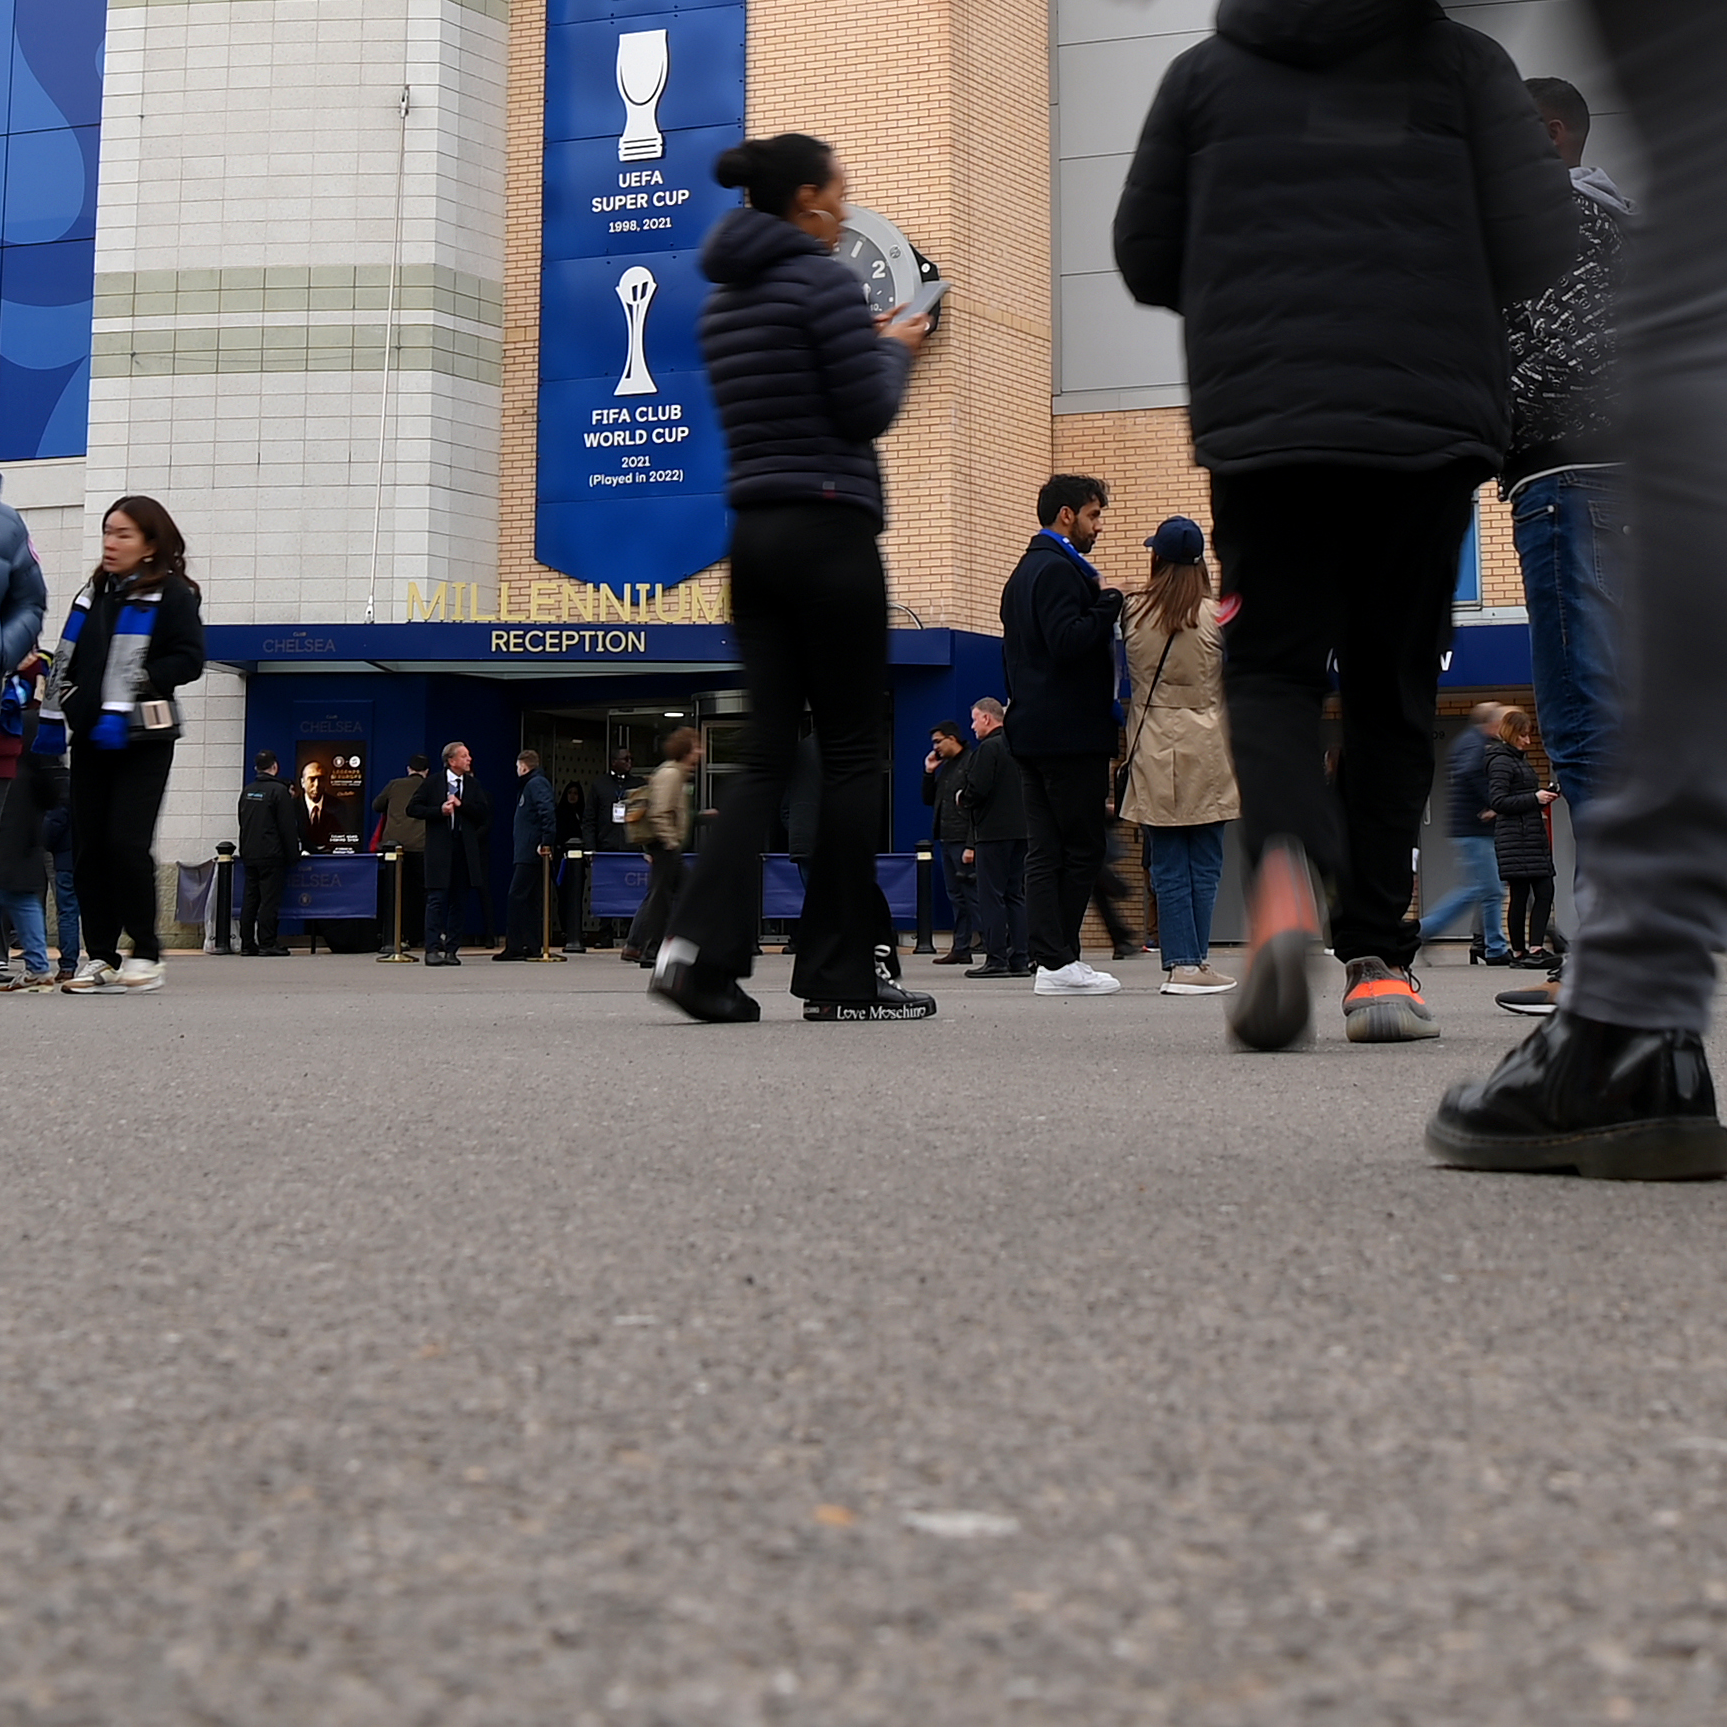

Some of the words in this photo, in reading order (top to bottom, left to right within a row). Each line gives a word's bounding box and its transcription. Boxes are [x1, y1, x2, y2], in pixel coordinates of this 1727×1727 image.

[618, 170, 663, 188] UEFA
[591, 193, 648, 213] SUPER
[653, 189, 690, 207] CUP
[608, 220, 640, 233] 1998,
[643, 217, 672, 230] 2021
[592, 408, 631, 425] FIFA
[635, 404, 682, 422] CLUB
[583, 430, 648, 448] WORLD
[652, 426, 689, 444] CUP
[621, 456, 651, 468] 2021
[589, 472, 633, 487] (Played
[635, 471, 646, 483] in
[649, 468, 684, 483] 2022)
[406, 582, 731, 623] MILLENNIUM
[262, 638, 336, 653] CHELSEA
[491, 630, 646, 653] RECEPTION
